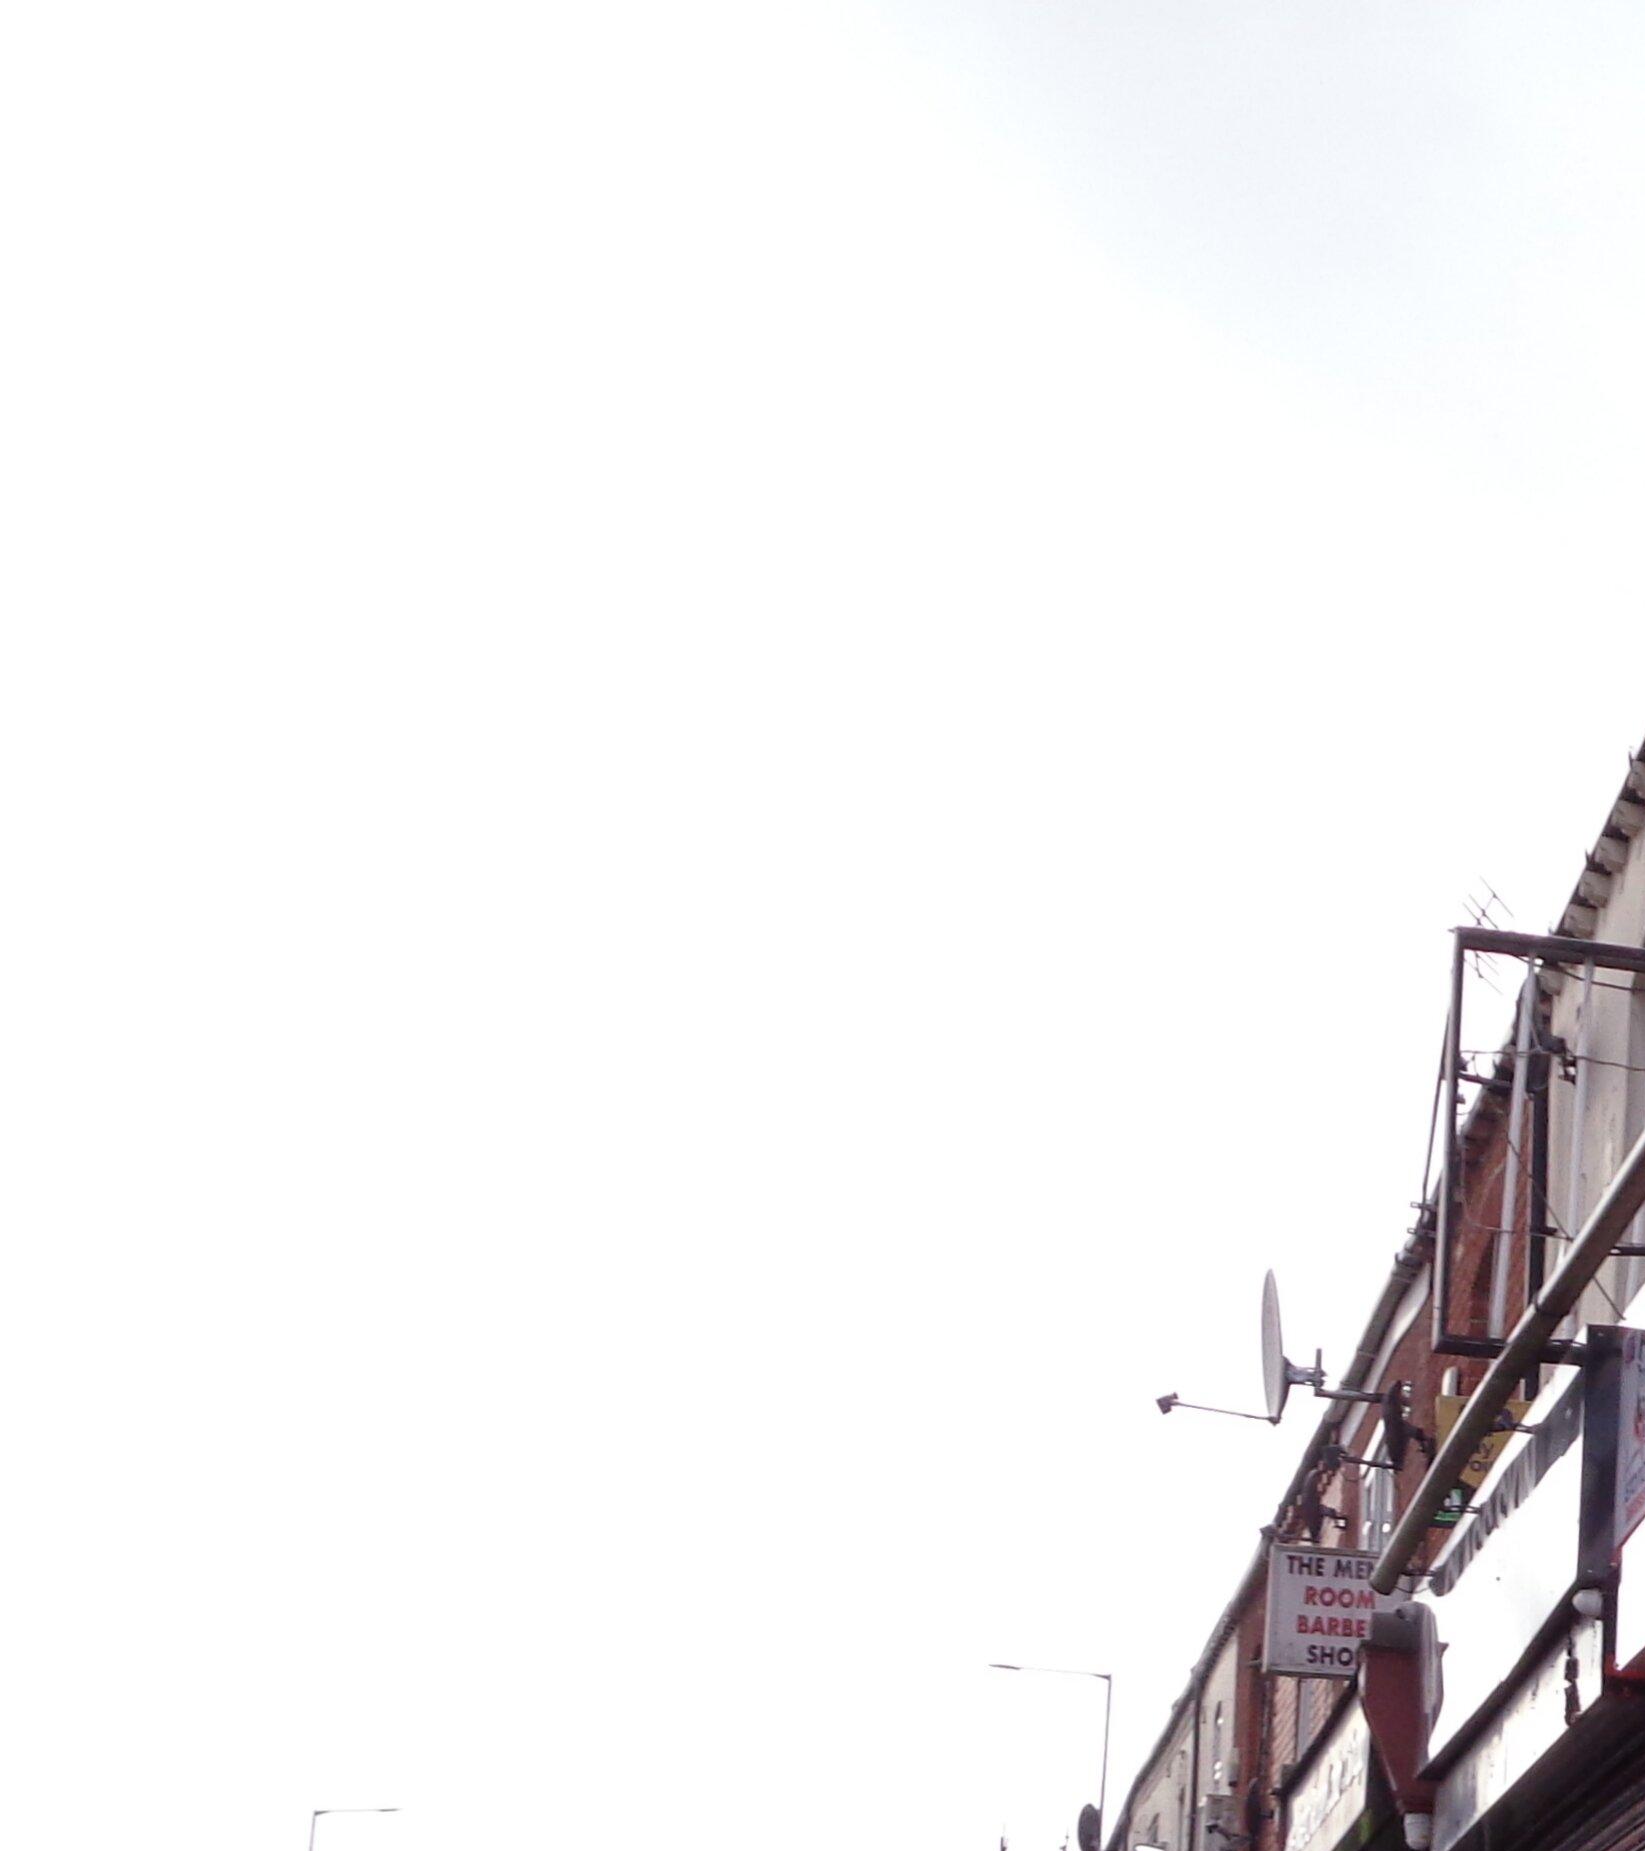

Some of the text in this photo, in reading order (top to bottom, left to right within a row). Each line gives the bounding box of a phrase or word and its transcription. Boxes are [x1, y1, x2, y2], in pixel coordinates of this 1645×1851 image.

[1286, 1555, 1376, 1580] THE MEN
[1304, 1585, 1376, 1609] ROOM
[1297, 1614, 1366, 1638] BARBE
[1306, 1645, 1354, 1667] SHO
